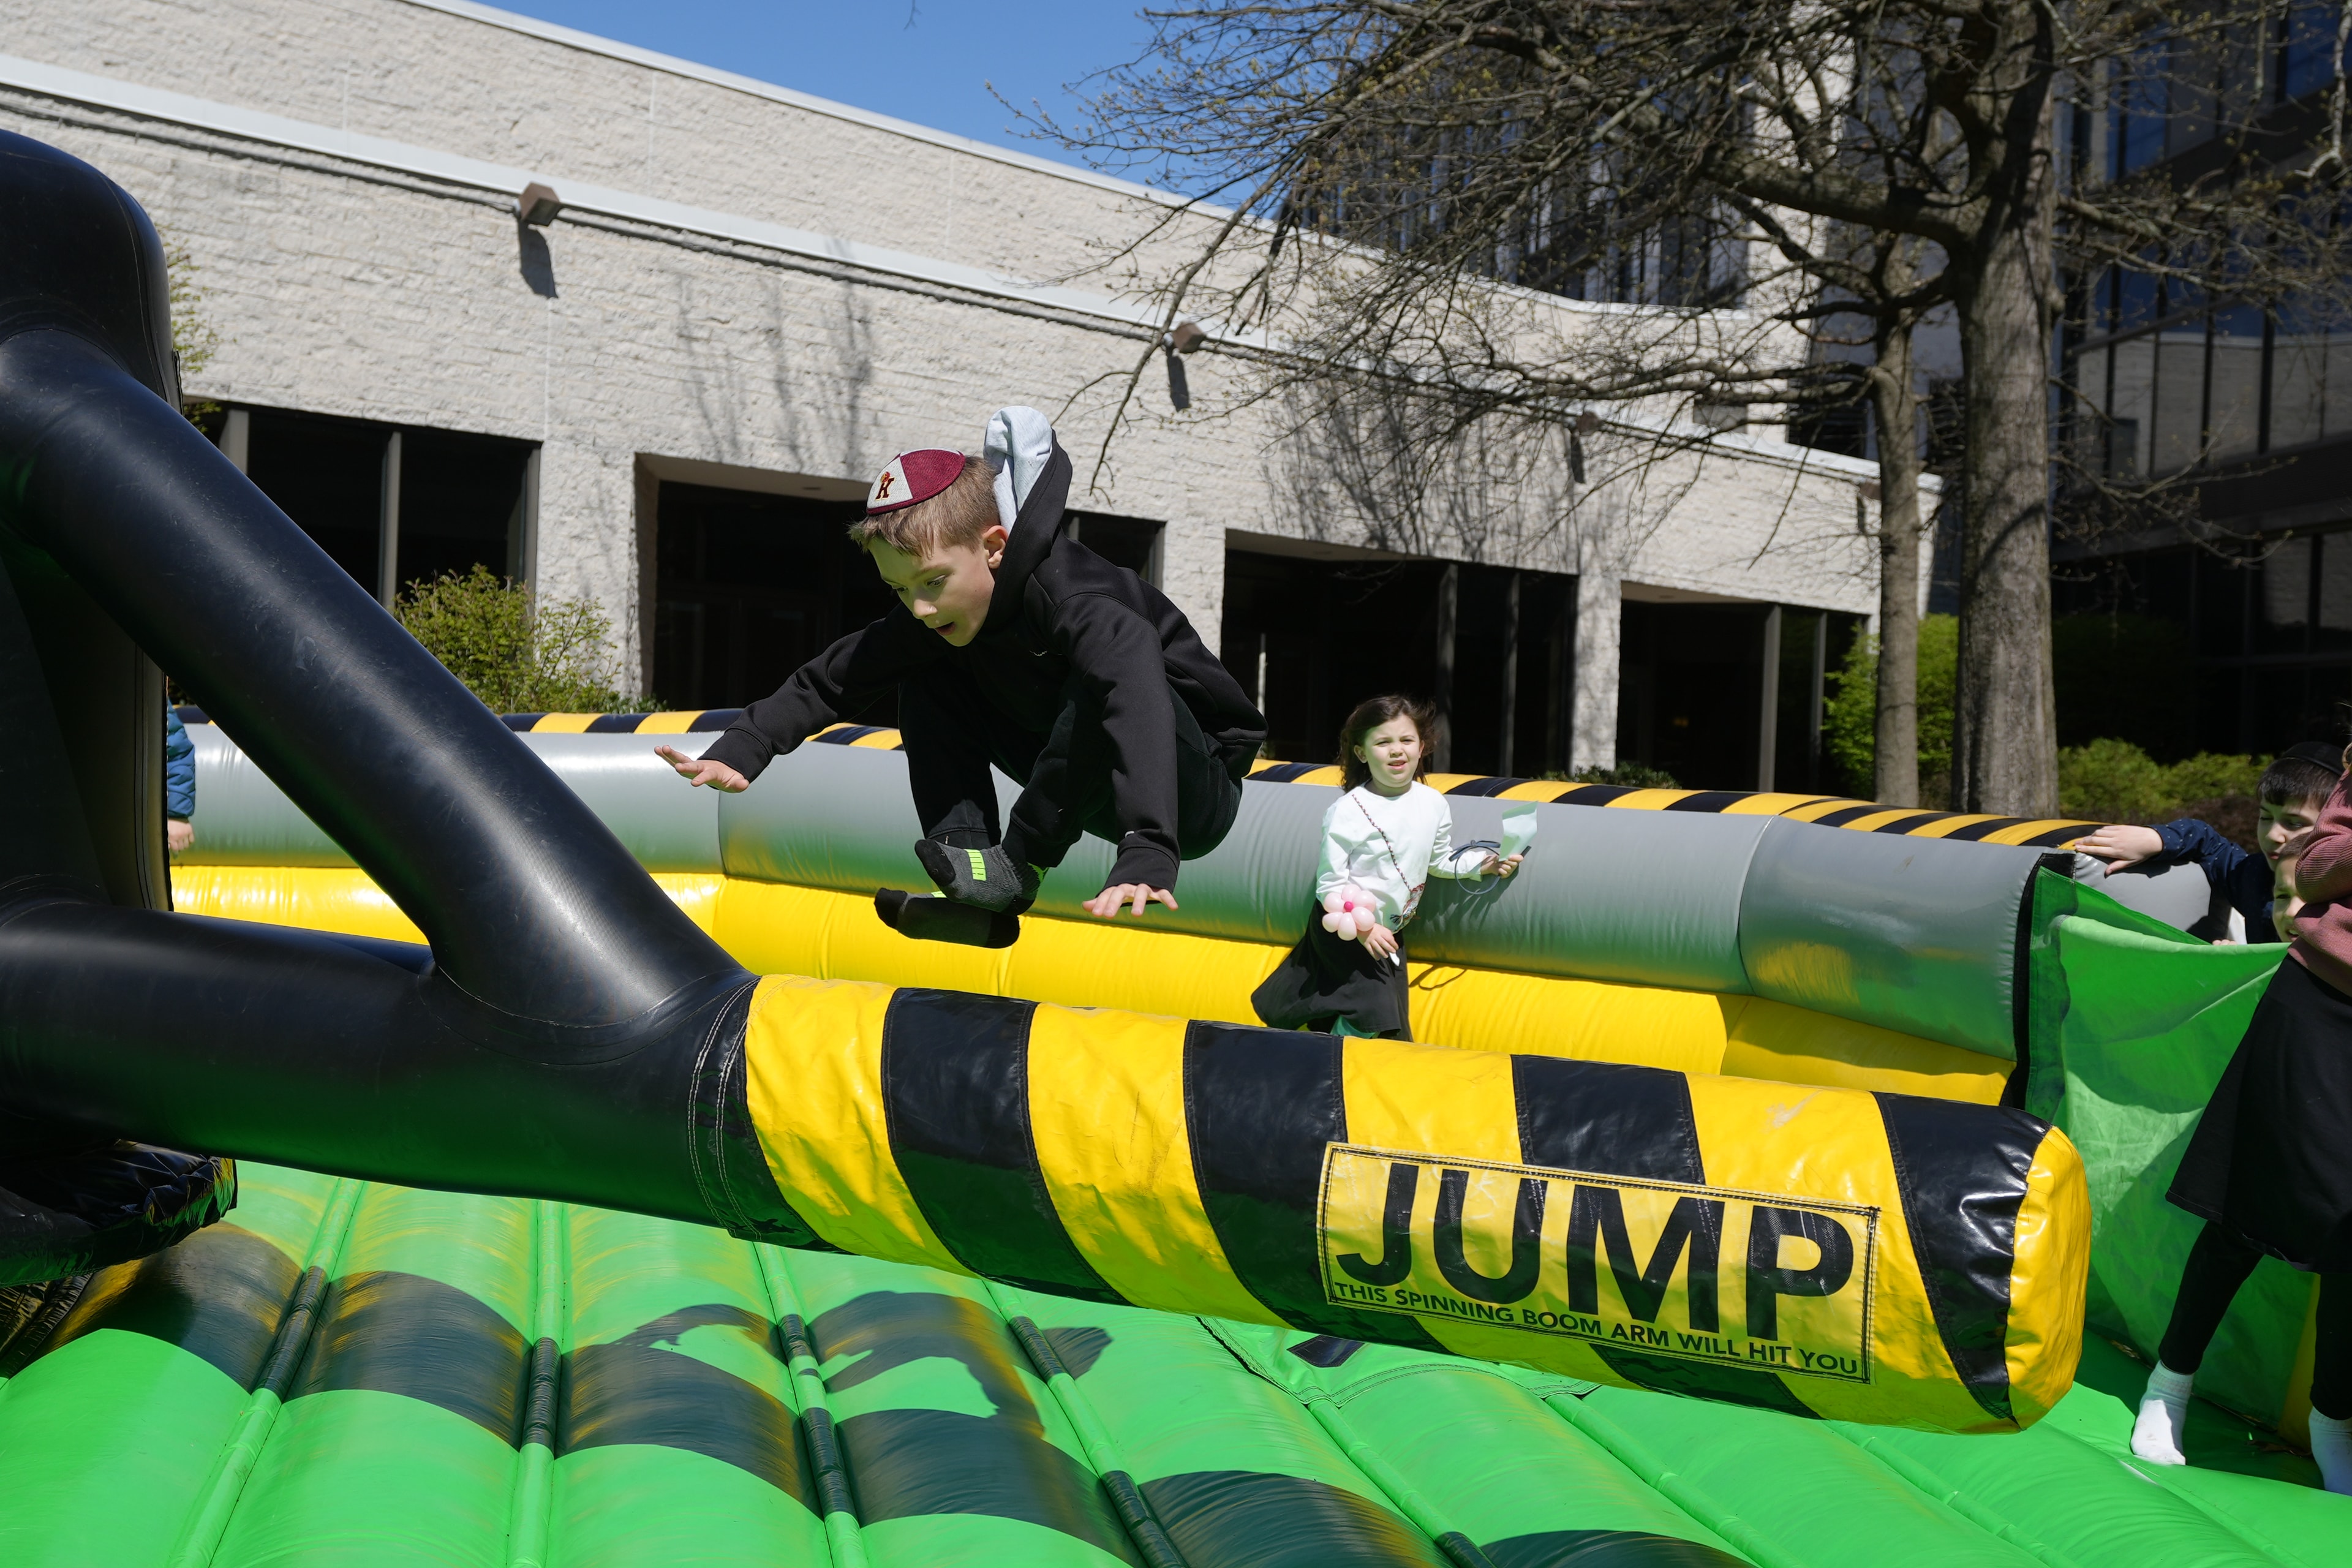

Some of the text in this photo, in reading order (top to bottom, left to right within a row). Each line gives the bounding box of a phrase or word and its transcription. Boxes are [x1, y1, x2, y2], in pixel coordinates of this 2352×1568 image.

[1336, 1162, 1855, 1340] JUMP
[1333, 1281, 1858, 1374] THIS SPINNING BOOM ARM WILL HIT YOU
